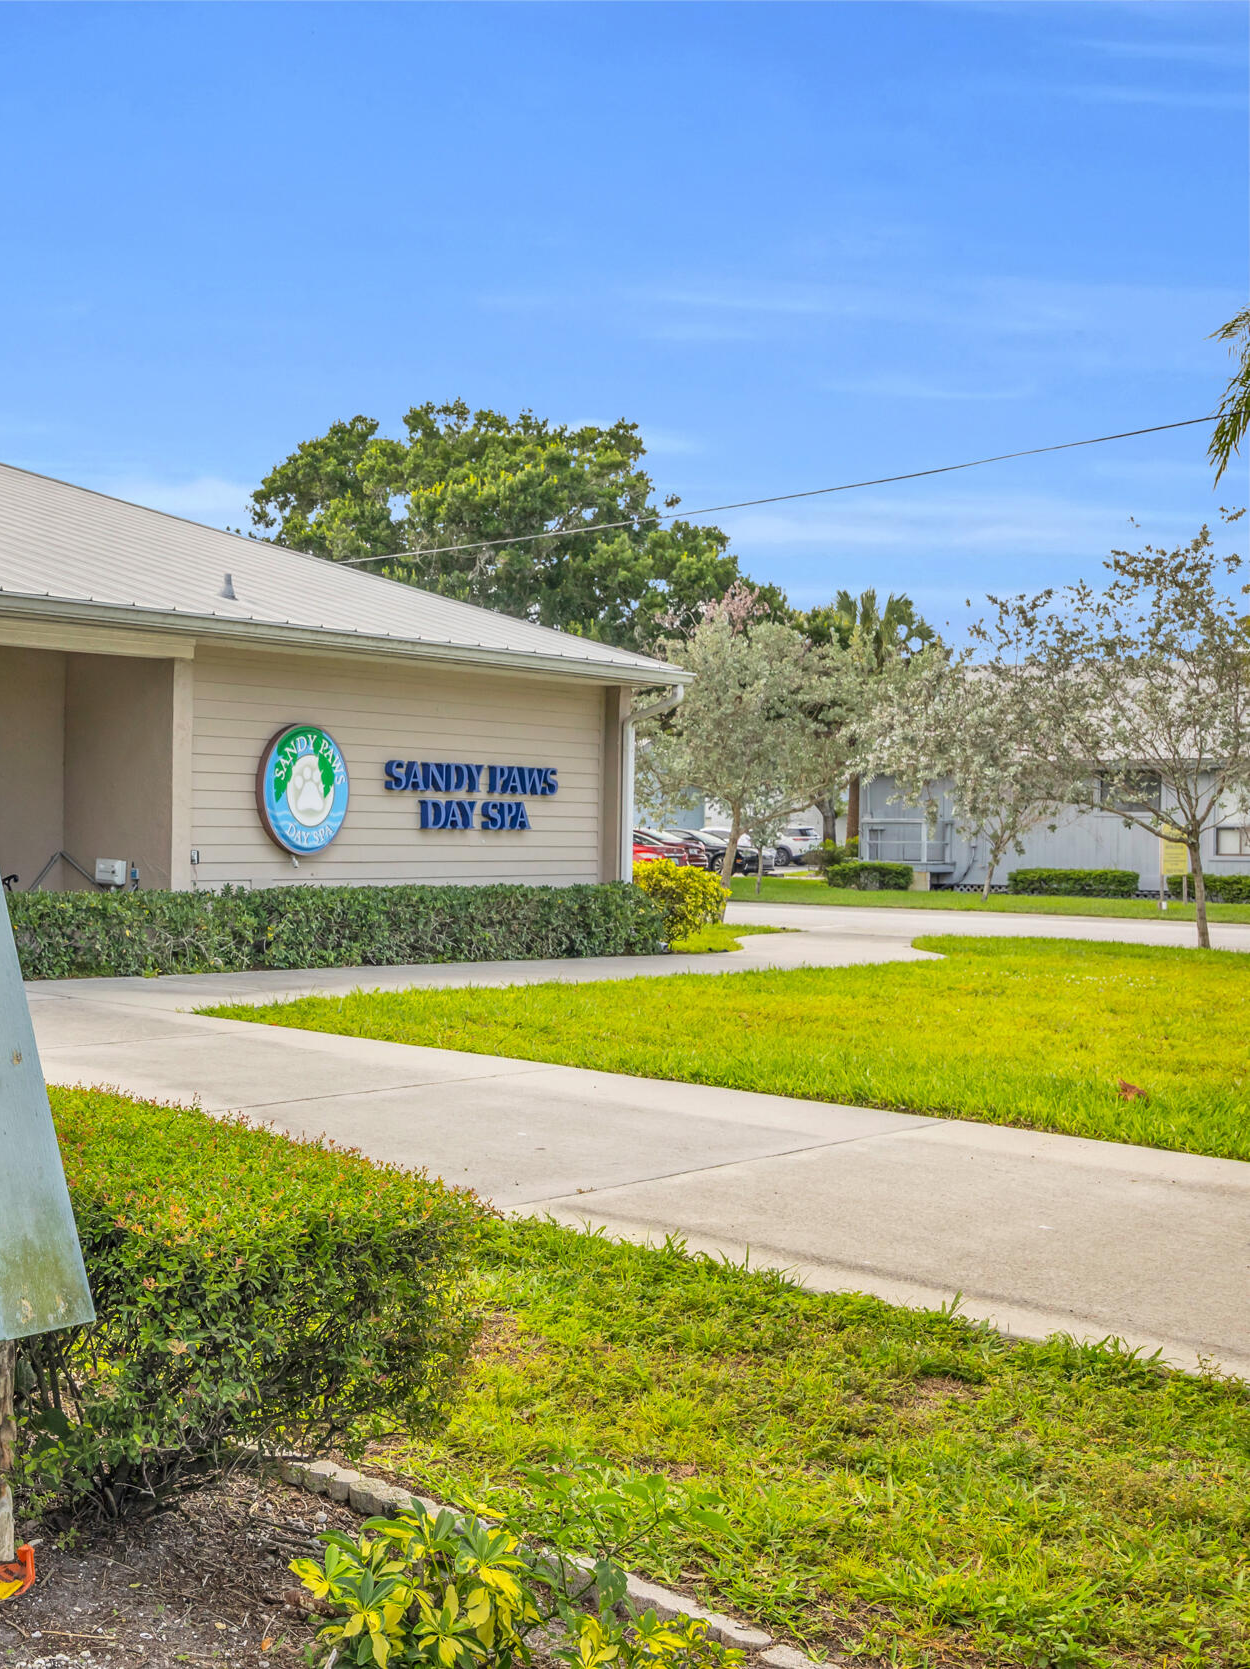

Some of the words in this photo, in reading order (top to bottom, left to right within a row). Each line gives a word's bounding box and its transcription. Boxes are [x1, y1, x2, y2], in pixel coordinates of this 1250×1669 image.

[275, 734, 317, 780] SANDY
[319, 738, 345, 785] PAWS
[384, 760, 484, 793] SANDY
[487, 765, 559, 796] PAWS
[418, 799, 478, 830] DAY
[481, 801, 531, 831] SPA
[286, 823, 311, 845] DAY
[313, 825, 334, 845] SPA
